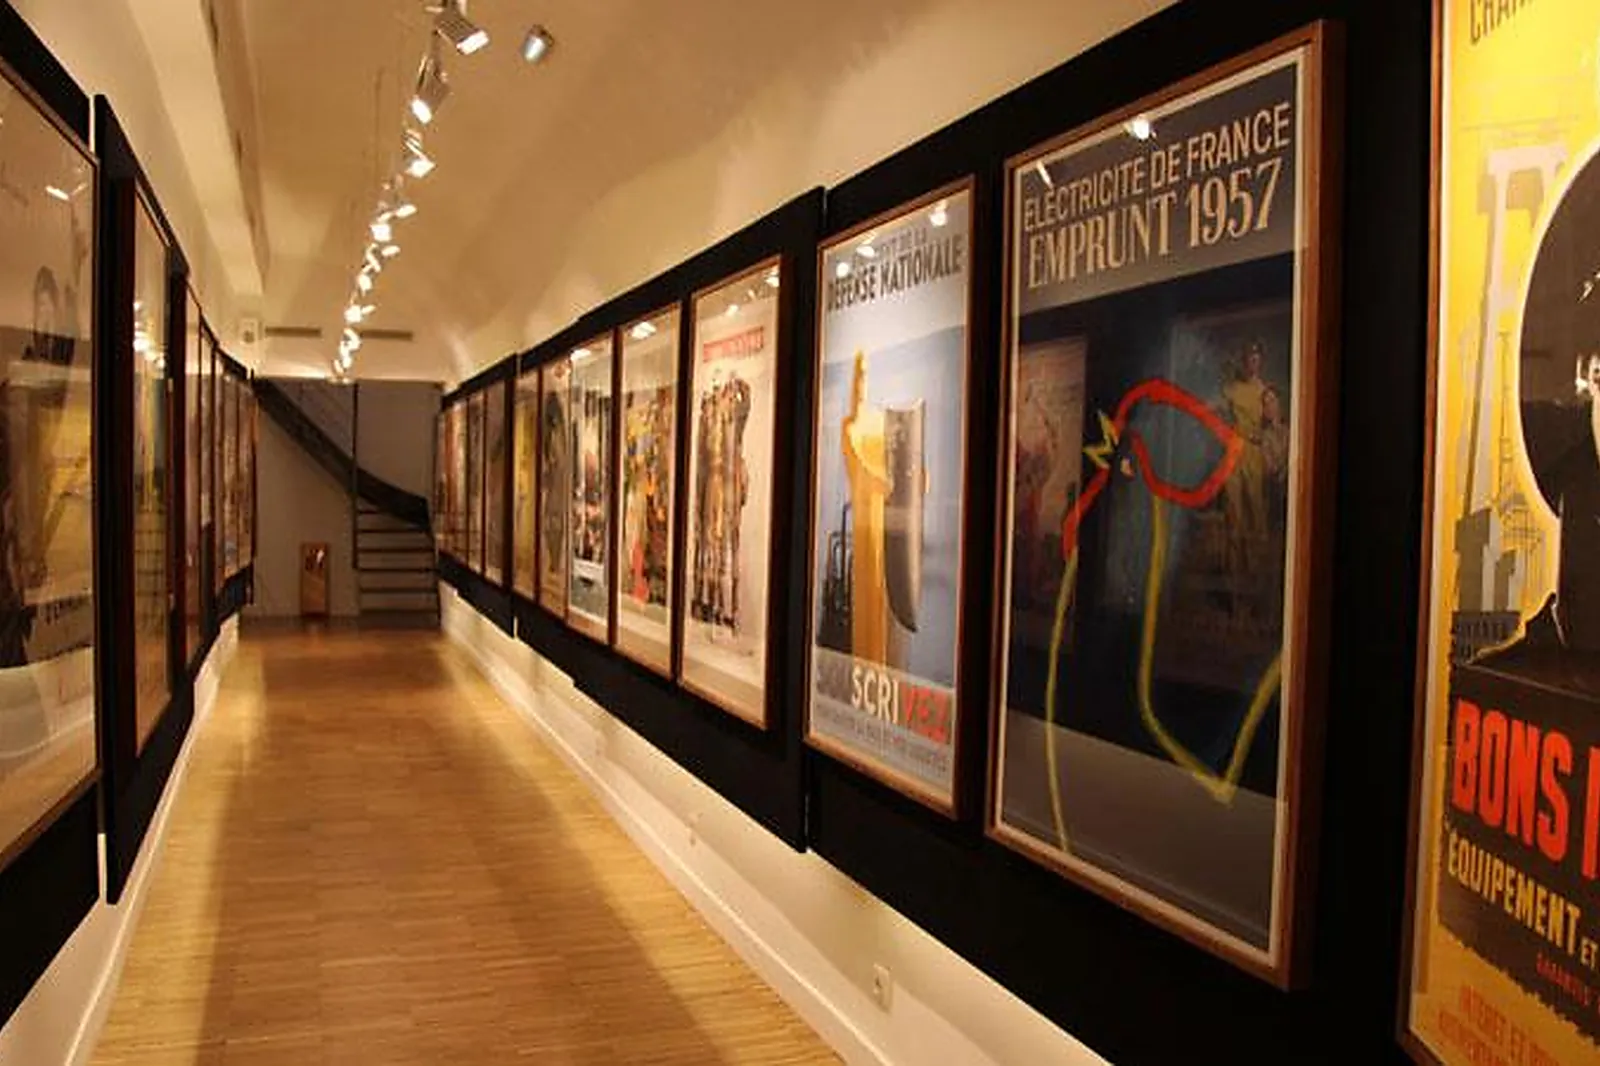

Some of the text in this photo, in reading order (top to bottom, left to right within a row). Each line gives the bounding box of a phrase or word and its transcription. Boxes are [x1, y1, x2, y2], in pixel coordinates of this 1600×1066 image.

[1150, 143, 1180, 188] DE
[1186, 102, 1291, 177] FRANCE
[1028, 191, 1177, 288] EMPRUNT
[1184, 156, 1283, 248] 1957
[1452, 697, 1573, 862] BONS
[1581, 936, 1599, 970] ET
